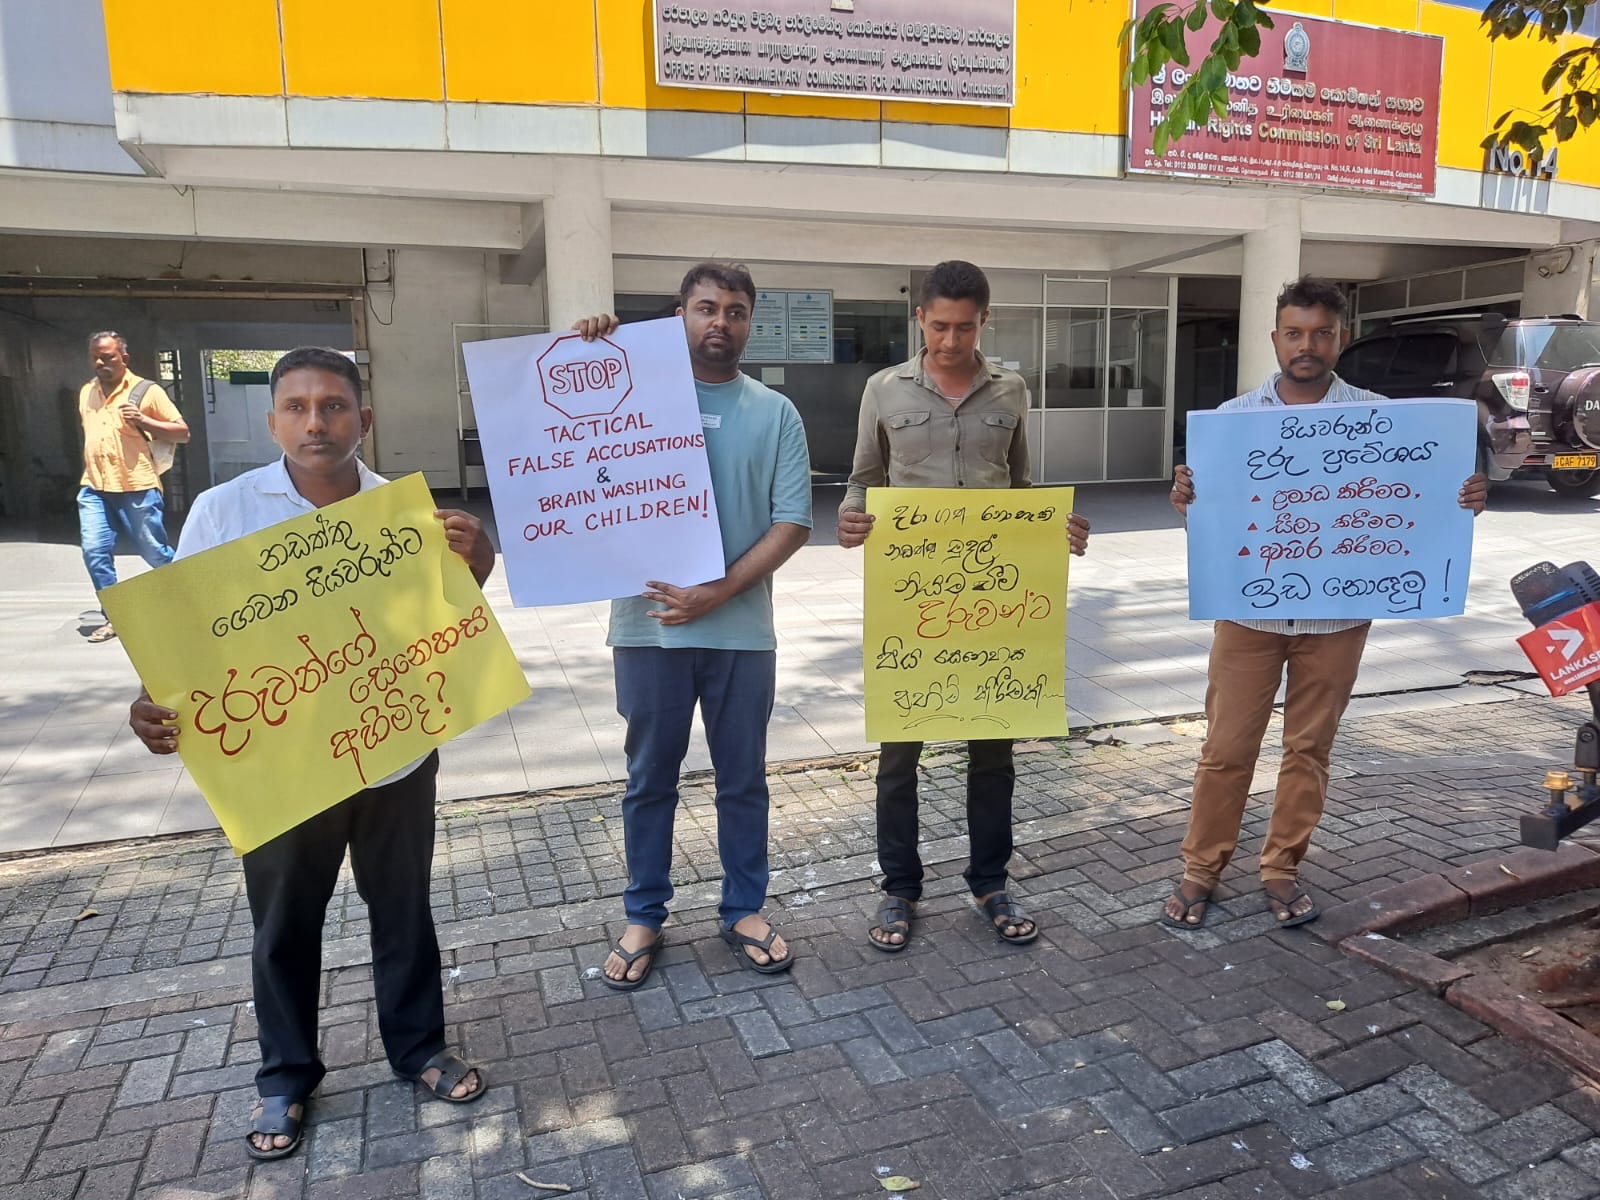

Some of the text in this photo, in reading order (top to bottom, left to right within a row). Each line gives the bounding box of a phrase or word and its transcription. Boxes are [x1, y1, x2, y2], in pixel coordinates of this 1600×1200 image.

[664, 61, 695, 79] OFFICE
[698, 62, 711, 79] OF
[713, 64, 730, 82] THE
[734, 65, 803, 86] PARLIAMENTARY
[806, 70, 867, 90] COMMISSIONER
[871, 75, 887, 92] FOR
[890, 77, 954, 96] ADMINISTRATION
[1207, 117, 1253, 138] Rights
[1259, 122, 1341, 146] Commission
[1345, 133, 1359, 148] of
[1364, 134, 1382, 150] Sri
[1386, 136, 1422, 154] Lanka
[1266, 103, 1334, 123] உரிமைகள்
[1348, 114, 1424, 137] ஆணைக்குழு
[549, 358, 623, 394] STOP
[544, 412, 653, 444] TACTICAL
[1280, 409, 1393, 441] පියවරුන්ට
[508, 434, 705, 477] FALSE ACCUSATIONS
[1246, 446, 1310, 480] දරු
[1559, 457, 1574, 468] CAF
[1577, 456, 1597, 467] 7179
[538, 473, 686, 513] BRAIN WASHING
[596, 467, 611, 484] &
[1336, 476, 1421, 500] කිරීමට,
[523, 489, 708, 541] OUR CHILDREN!
[1266, 508, 1415, 535] සීමා කිරීමට,
[1259, 534, 1411, 575] අවහිර කිරීමට,
[1241, 572, 1312, 609] ඉඩ
[1322, 570, 1427, 613] නොදෙමු
[212, 588, 299, 638] ගෙවන
[916, 588, 1051, 639] දරුවන්ට
[190, 605, 379, 757] දරුවන්ගේ
[330, 671, 453, 786] අහිමිද?
